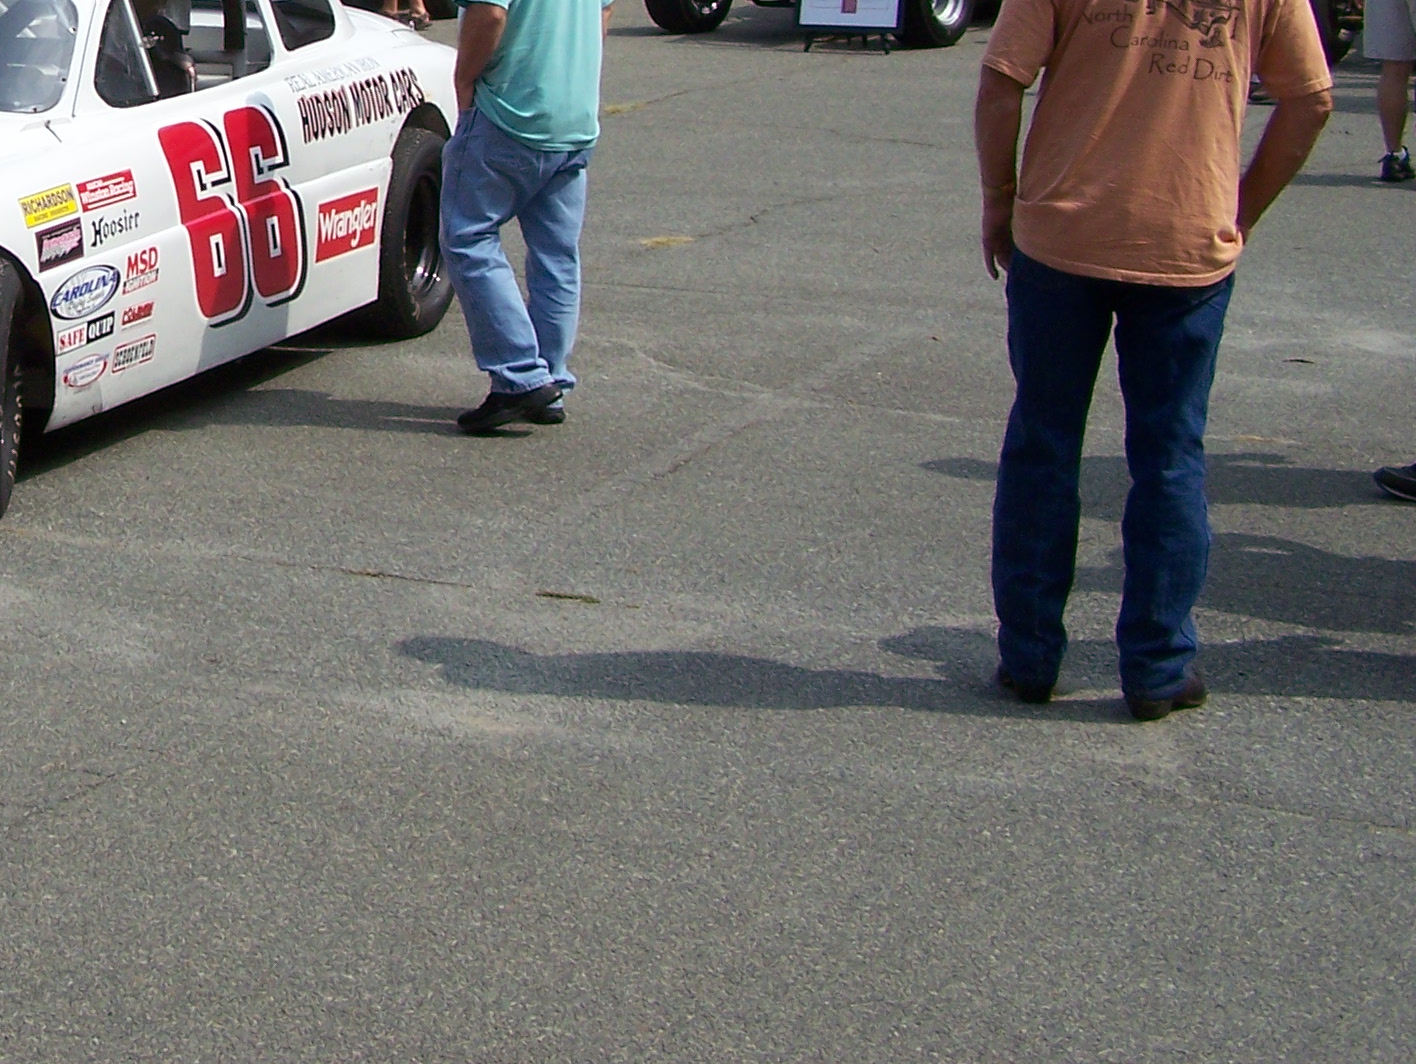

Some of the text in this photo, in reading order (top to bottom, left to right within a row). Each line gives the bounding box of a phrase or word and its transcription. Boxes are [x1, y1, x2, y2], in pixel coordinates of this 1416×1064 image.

[1110, 25, 1190, 51] Carolina
[1149, 53, 1234, 83] Red Dirt
[297, 66, 425, 144] HUDSON MOTOR CARS
[21, 189, 75, 215] RICHARDSON
[158, 105, 307, 326] 66
[91, 209, 140, 248] Hoosier
[319, 199, 377, 248] Wrangler
[126, 247, 158, 279] MSD
[52, 269, 120, 308] CAROLINA
[59, 316, 114, 351] SAFE QUIP
